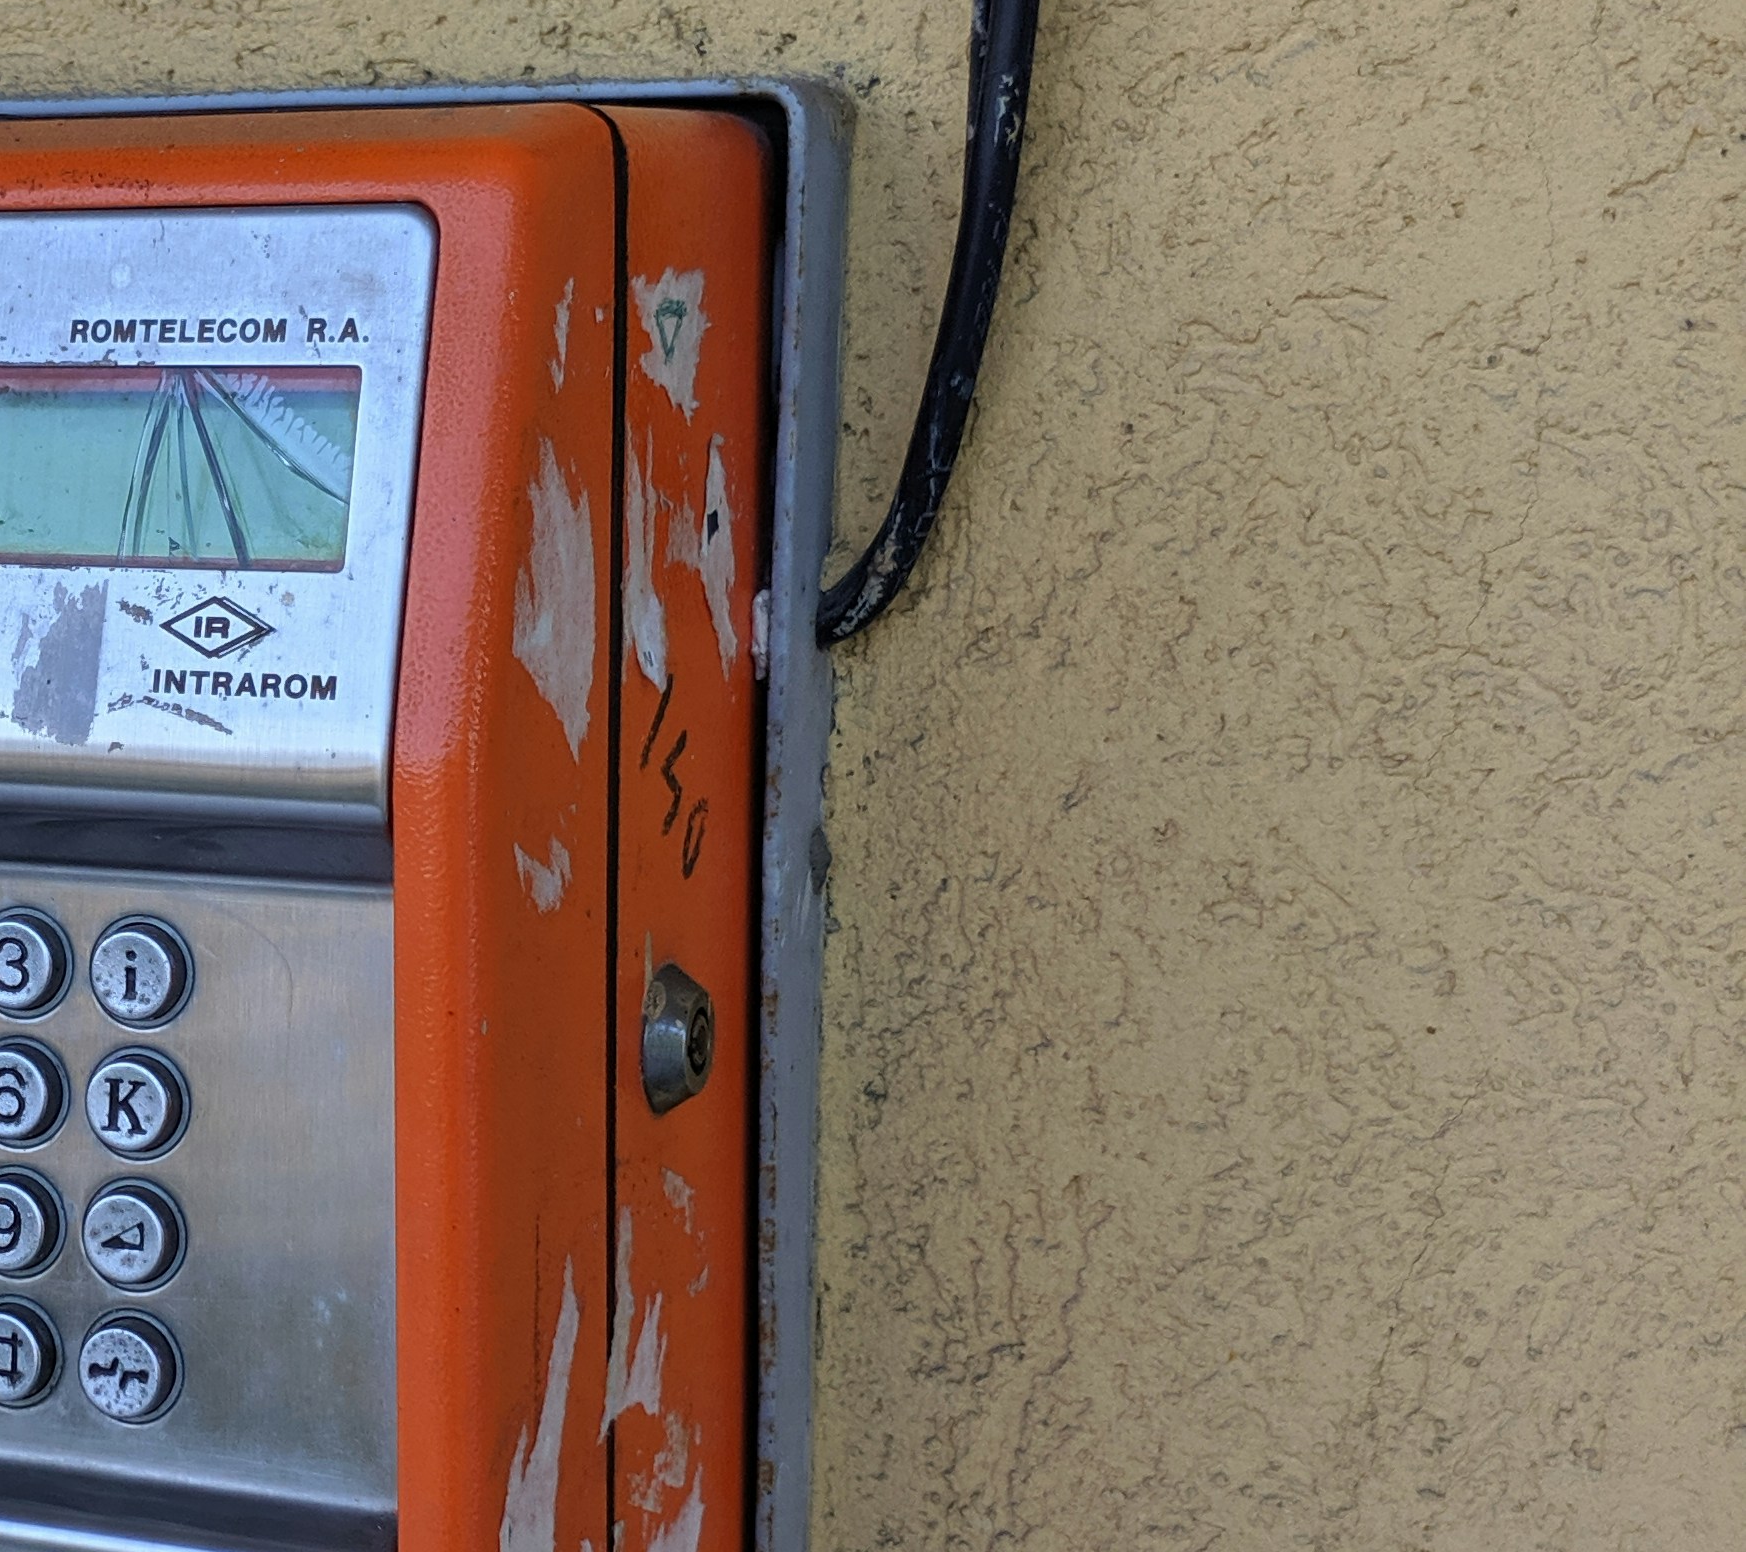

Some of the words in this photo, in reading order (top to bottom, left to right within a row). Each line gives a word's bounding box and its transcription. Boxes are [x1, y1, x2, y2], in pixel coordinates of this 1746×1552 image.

[69, 318, 288, 344] ROMTELECOM
[306, 317, 370, 344] R.A.
[193, 616, 231, 639] IR
[153, 669, 338, 701] INTRAROM
[123, 949, 137, 1000] i
[100, 1078, 147, 1135] K
